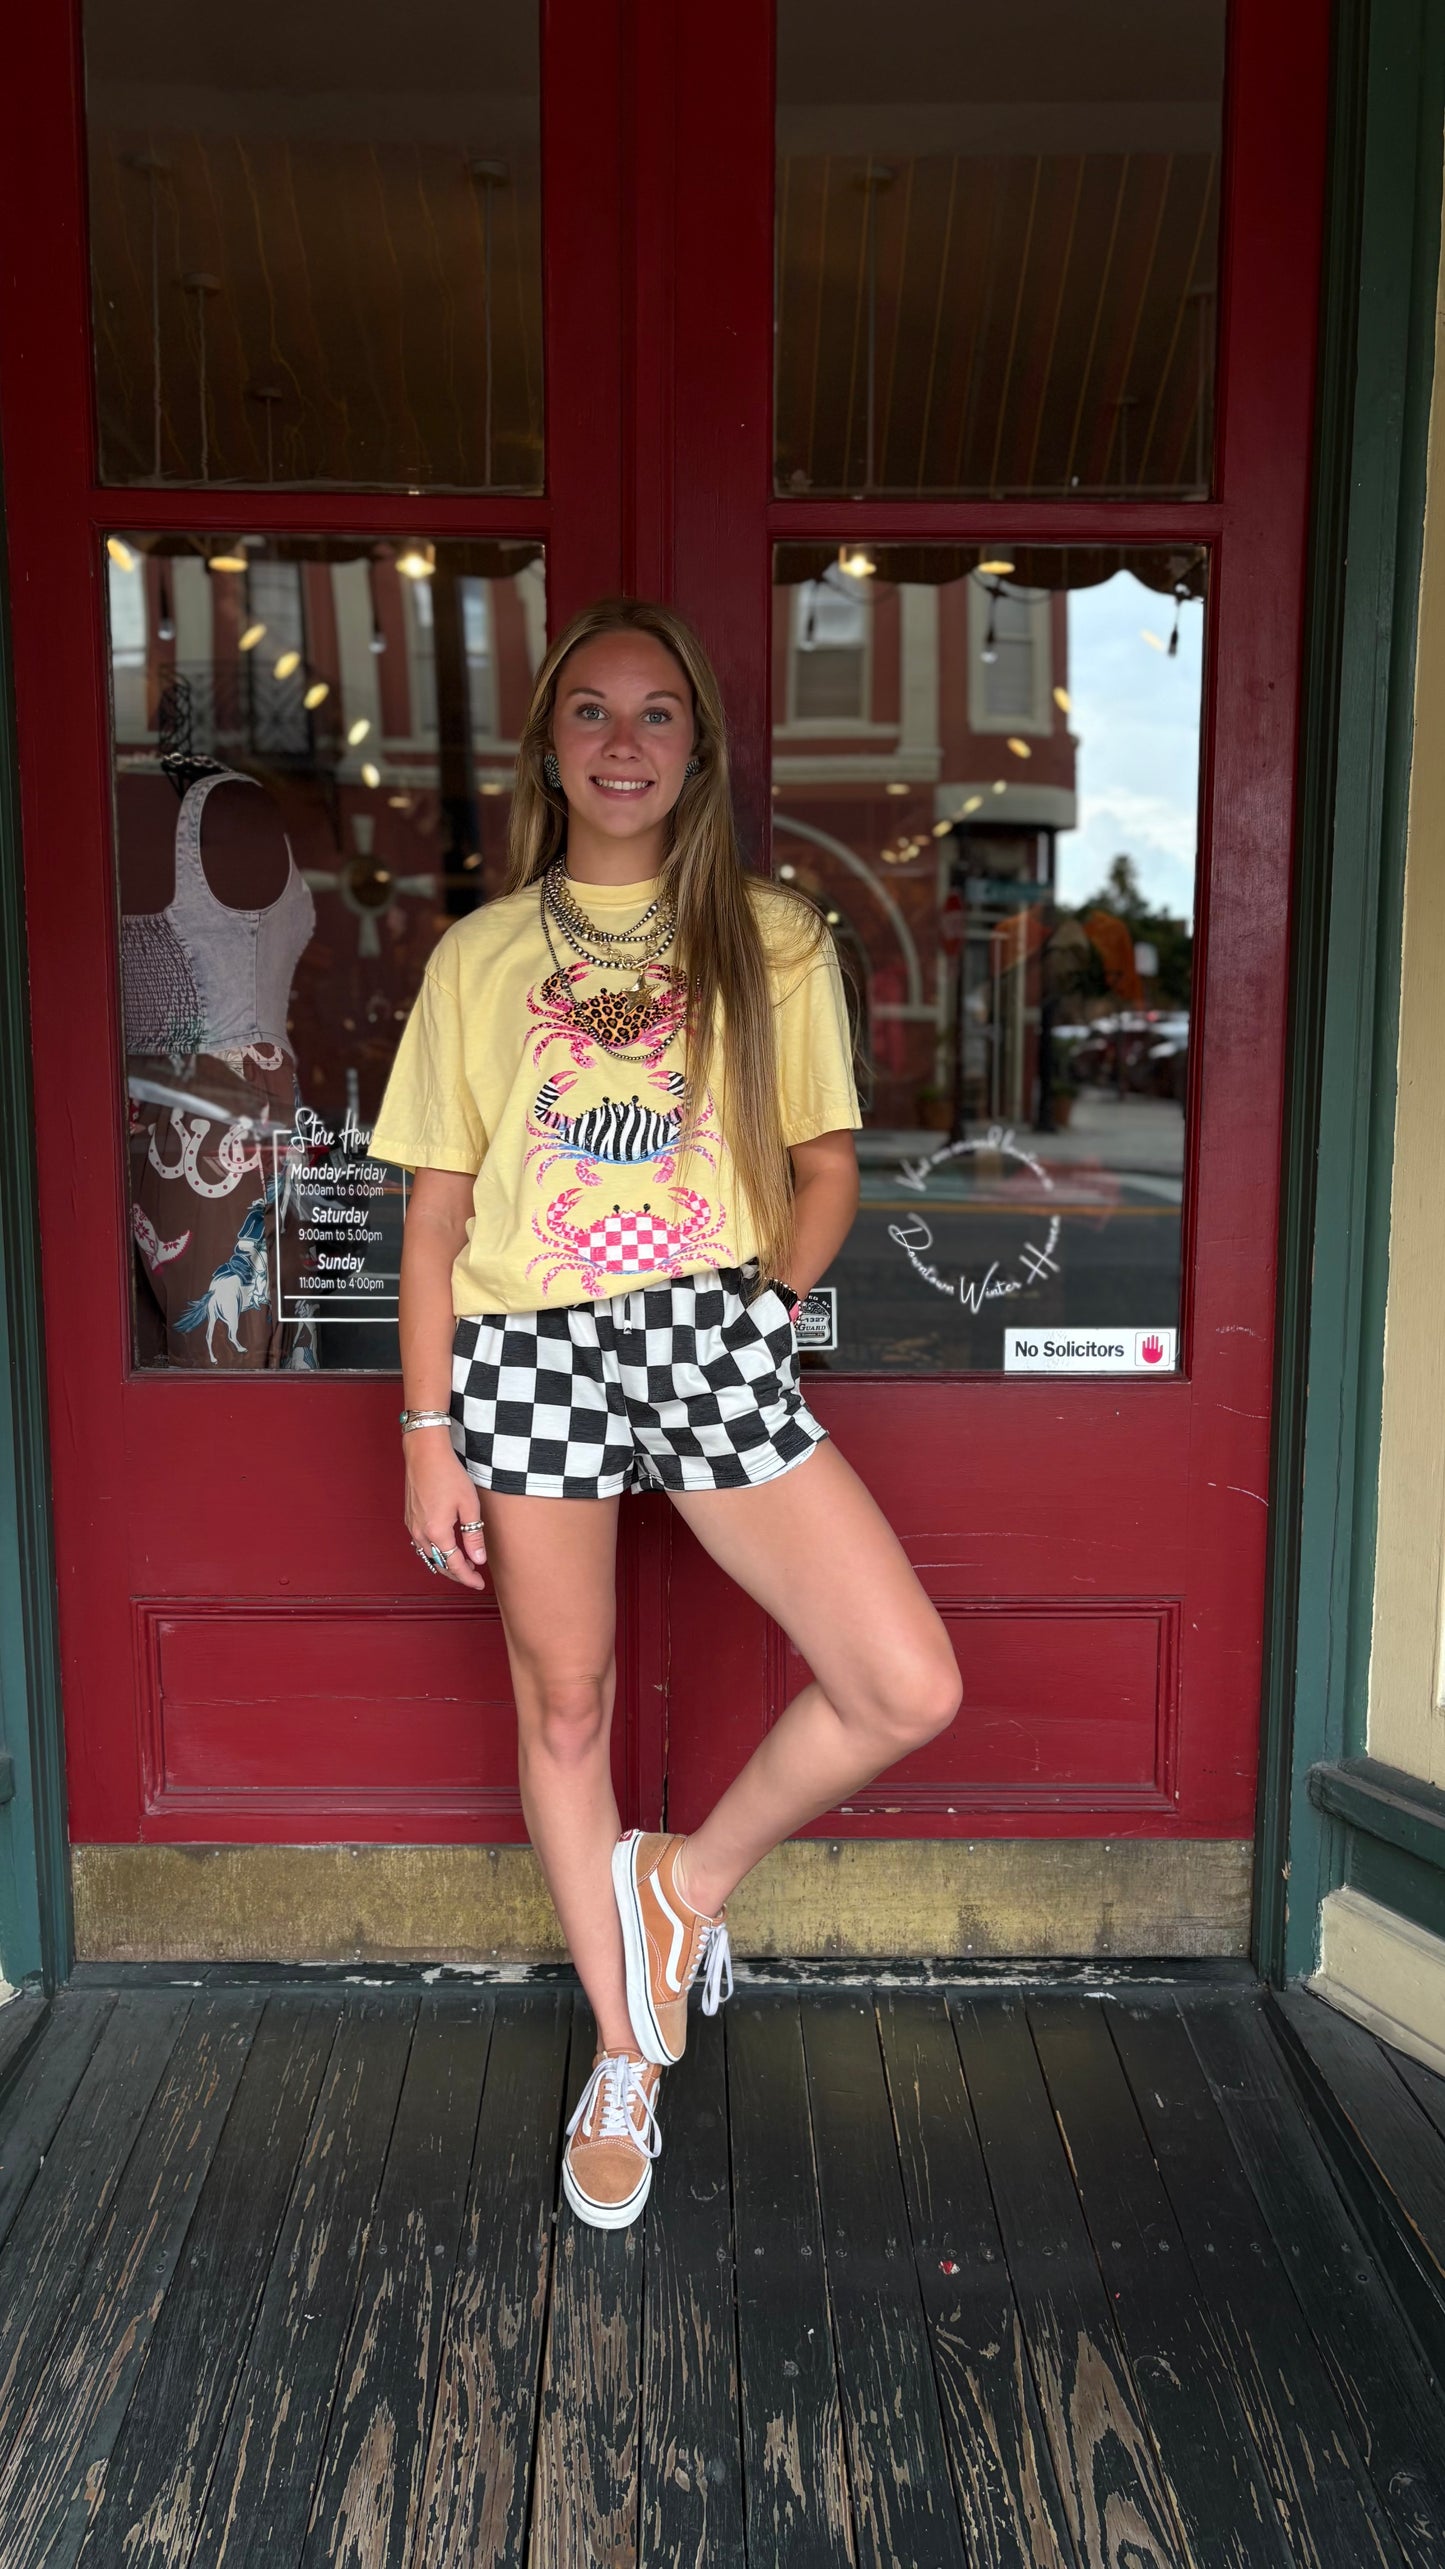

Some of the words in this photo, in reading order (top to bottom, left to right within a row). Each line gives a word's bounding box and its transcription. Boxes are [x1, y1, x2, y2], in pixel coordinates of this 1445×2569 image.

[291, 1107, 335, 1153] Store
[339, 1108, 375, 1154] Hou
[290, 1163, 387, 1183] Monday-Friday
[295, 1184, 334, 1196] 10:00am
[336, 1185, 346, 1196] to
[311, 1206, 369, 1227] Saturday
[298, 1228, 333, 1241] 9:00am
[335, 1229, 345, 1240] to
[317, 1253, 365, 1273] Sunday
[888, 1212, 954, 1295] Downtown
[960, 1261, 1021, 1314] Winter
[299, 1276, 335, 1289] 11:00am
[337, 1278, 347, 1289] to
[1015, 1341, 1039, 1357] No
[1043, 1341, 1125, 1357] Solicitors
